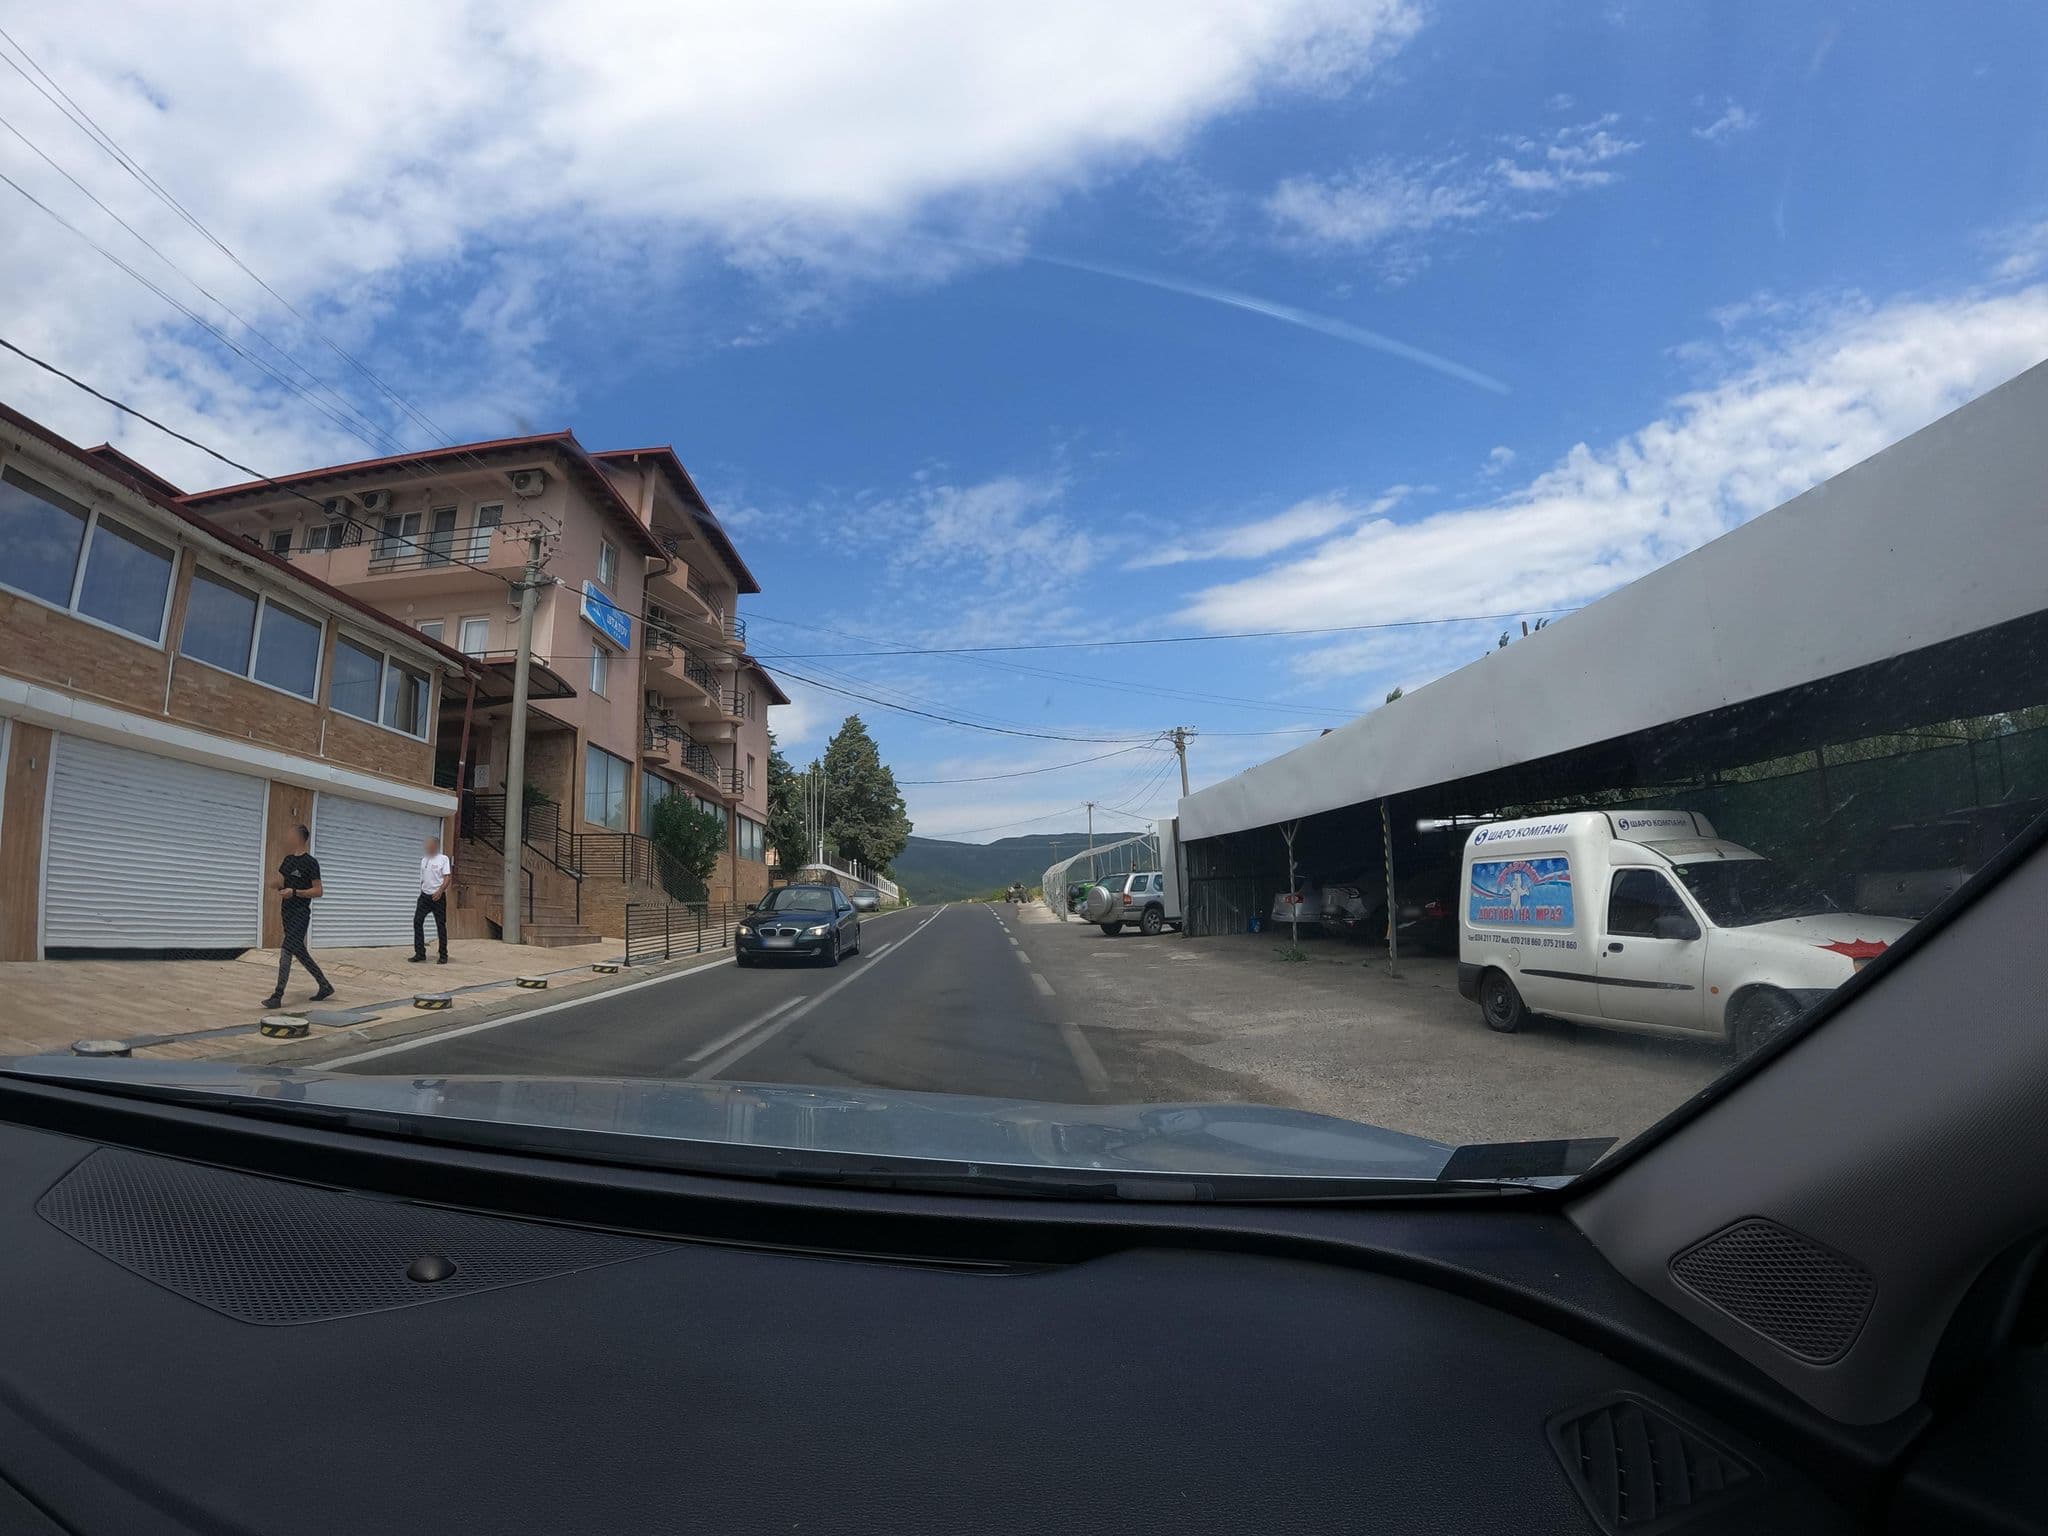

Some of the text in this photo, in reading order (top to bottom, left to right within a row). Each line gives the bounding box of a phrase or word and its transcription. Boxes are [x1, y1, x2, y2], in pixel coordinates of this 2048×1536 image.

[1630, 819, 1652, 828] ШАРО
[1488, 823, 1569, 841] ШАРО КОМПАНИ
[1478, 905, 1563, 921] ДОСТАВА НА МРАЗ
